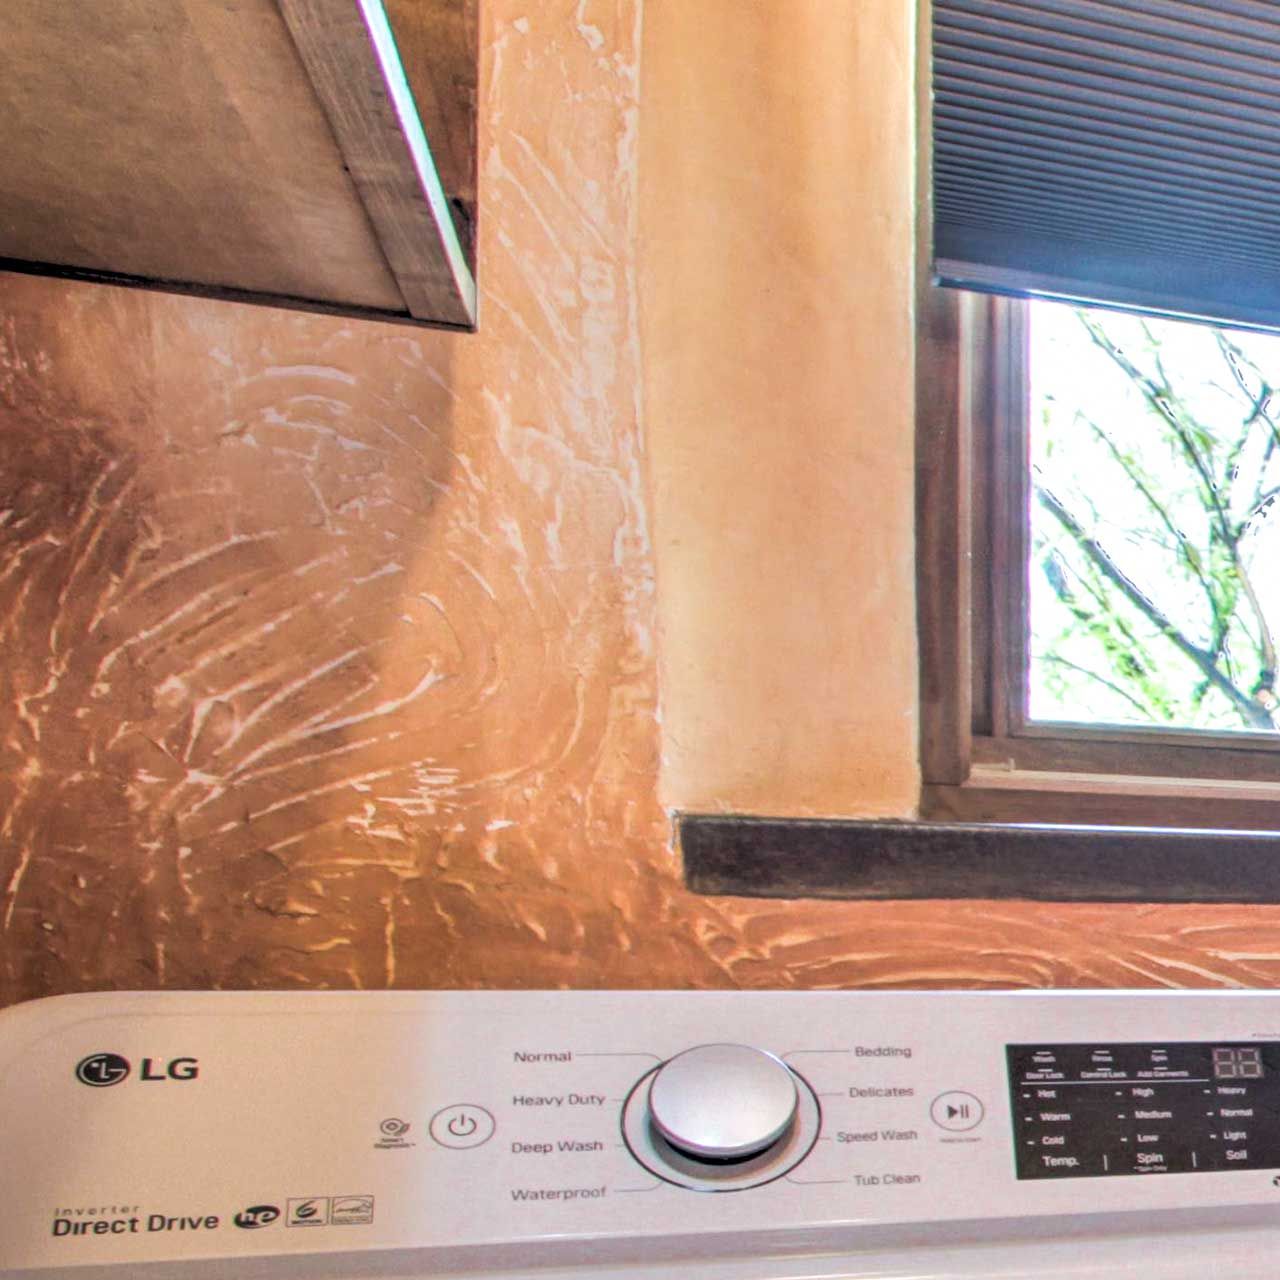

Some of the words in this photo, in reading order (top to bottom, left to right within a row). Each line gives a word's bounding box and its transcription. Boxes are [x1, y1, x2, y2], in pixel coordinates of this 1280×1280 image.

[513, 1050, 572, 1064] Normal
[855, 1045, 912, 1060] Bedding
[139, 1057, 200, 1081] LG
[848, 1085, 915, 1099] Delicates
[1132, 1087, 1156, 1099] High
[1217, 1086, 1247, 1096] Heavy
[512, 1094, 564, 1109] Heavy
[568, 1092, 606, 1107] Duty
[1040, 1112, 1071, 1122] Warm
[1134, 1109, 1172, 1119] Medium
[1220, 1108, 1253, 1117] Normal
[837, 1130, 877, 1145] Speed
[880, 1128, 918, 1142] Wash
[1042, 1135, 1065, 1145] Cold
[1137, 1133, 1160, 1144] Low
[1223, 1131, 1247, 1142] Light
[511, 1141, 551, 1156] Deep
[555, 1138, 604, 1153] Wash
[1042, 1155, 1080, 1168] Temp.
[1136, 1152, 1164, 1166] Spin
[1226, 1149, 1247, 1161] Soil
[854, 1173, 880, 1187] Tub
[884, 1171, 921, 1186] Clean
[511, 1186, 607, 1202] Waterproof
[52, 1216, 139, 1237] Direct
[147, 1211, 219, 1233] Drive
